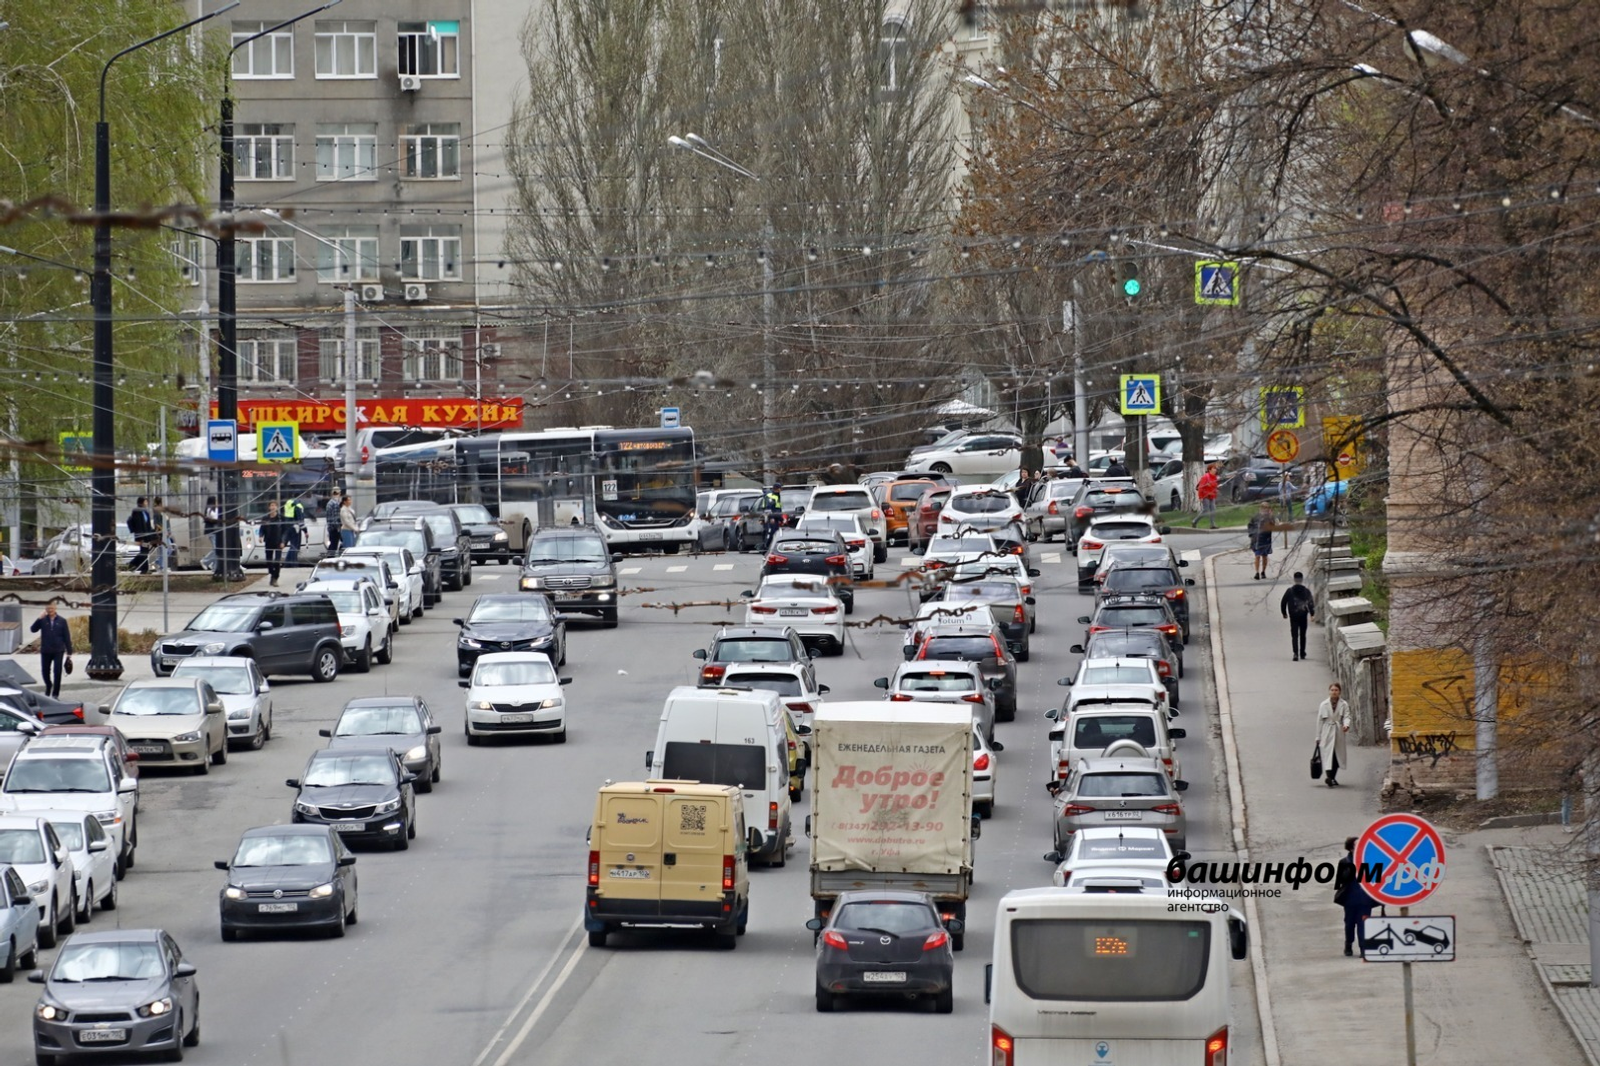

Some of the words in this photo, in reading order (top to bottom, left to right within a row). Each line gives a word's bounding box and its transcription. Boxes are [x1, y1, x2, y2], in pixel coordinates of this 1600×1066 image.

[422, 404, 518, 423] КУХНЯ
[603, 483, 616, 492] 122
[744, 737, 755, 745] 163
[837, 743, 911, 754] ЕЖЕНЕДЕЛЬНАЯ
[913, 745, 946, 754] ГАЗЕТА
[831, 764, 946, 792] Доброе
[859, 790, 940, 814] утро!
[847, 836, 926, 845] www.dobutro.ru
